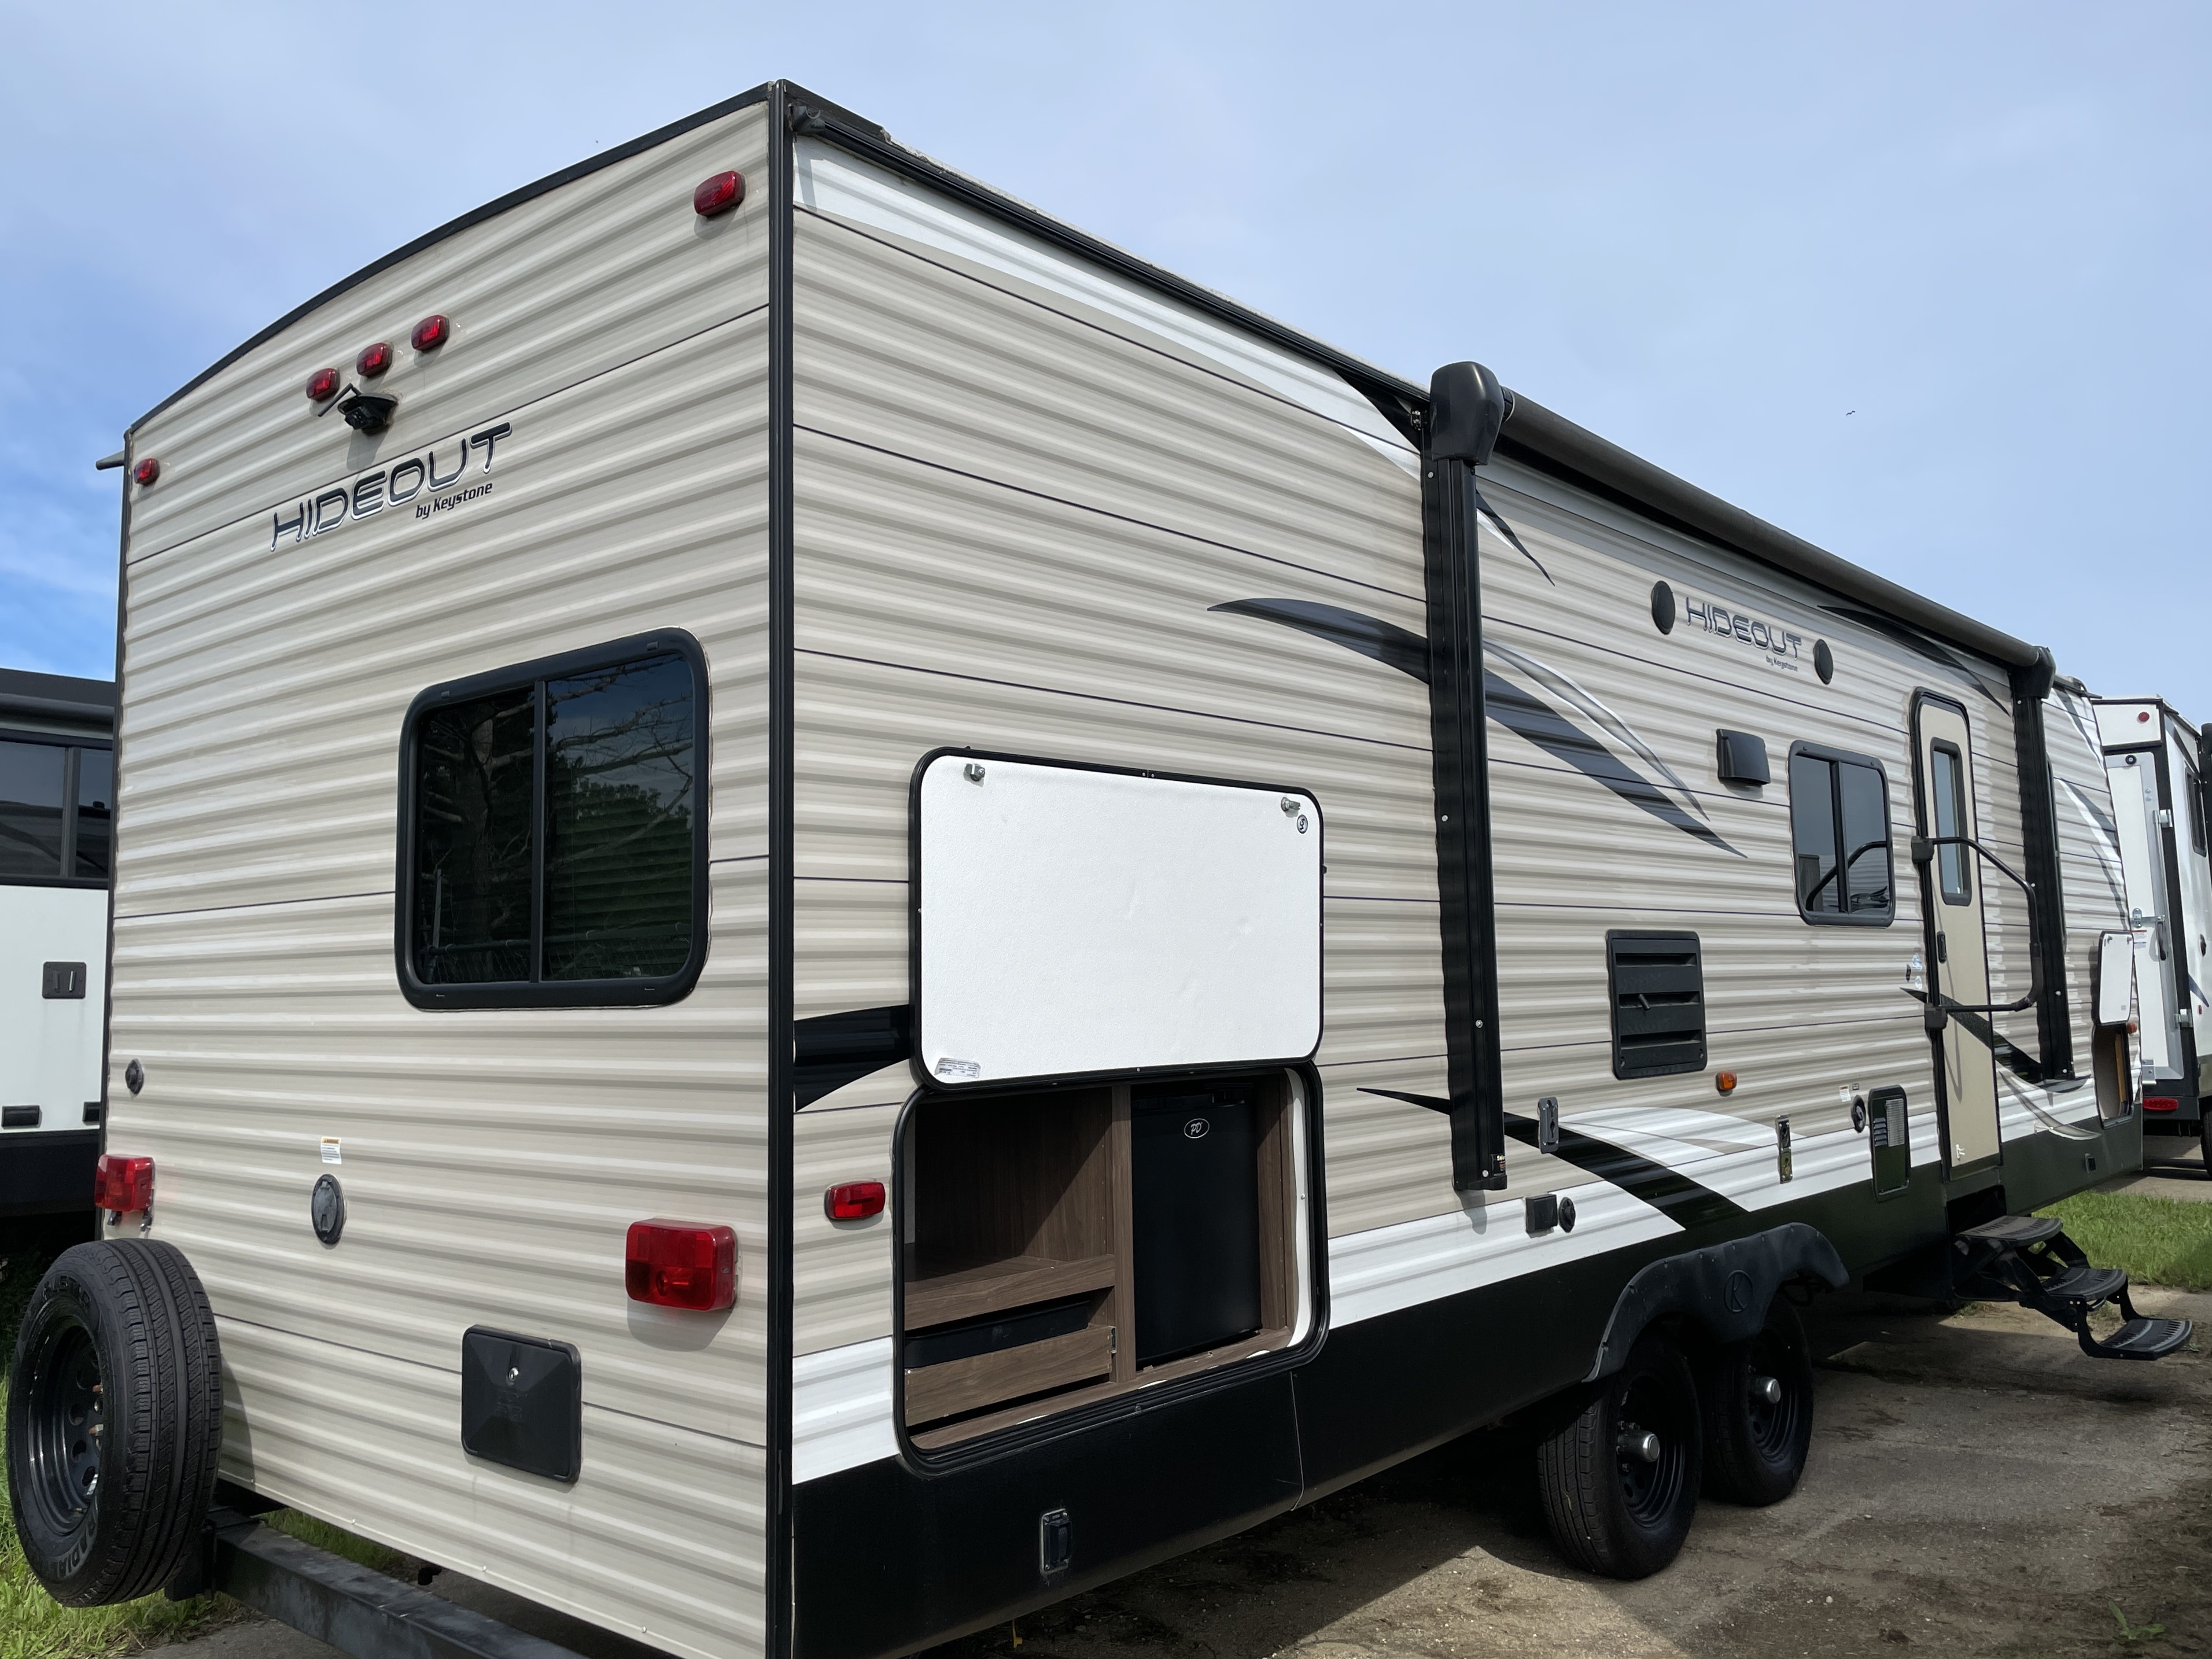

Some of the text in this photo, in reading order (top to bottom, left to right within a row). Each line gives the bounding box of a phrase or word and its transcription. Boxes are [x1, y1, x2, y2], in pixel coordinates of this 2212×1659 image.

[270, 421, 513, 552] HIDEOUT
[415, 482, 493, 519] by Keystone
[1686, 596, 1802, 661] HIDEOUT
[1766, 655, 1798, 672] by Keystone
